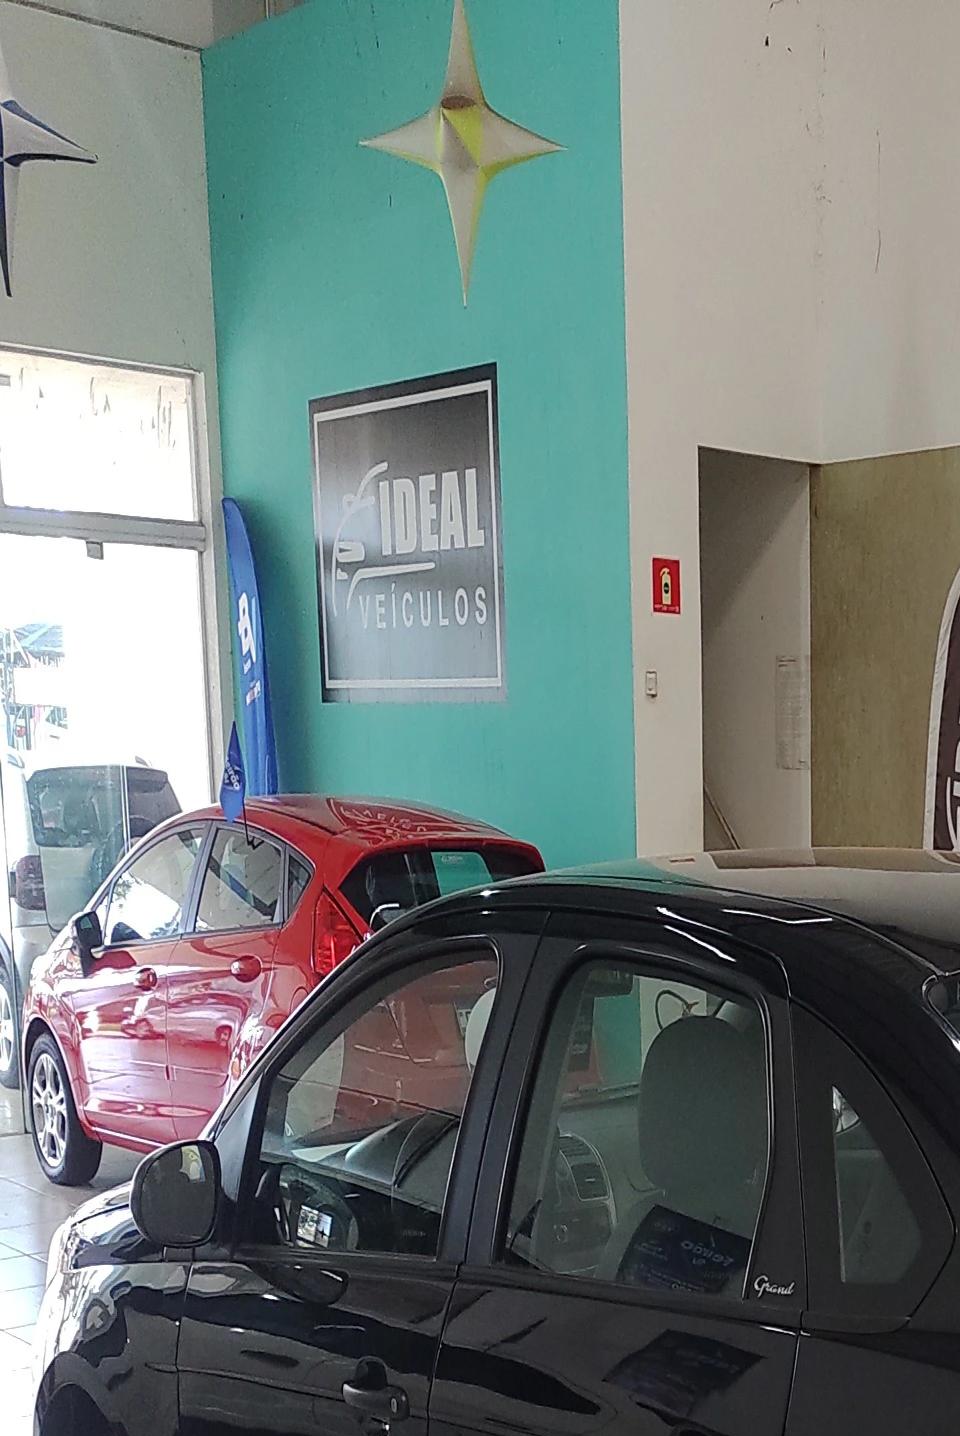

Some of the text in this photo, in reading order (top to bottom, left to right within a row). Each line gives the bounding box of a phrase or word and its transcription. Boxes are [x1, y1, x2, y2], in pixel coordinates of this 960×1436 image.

[379, 468, 485, 556] IDEAL
[359, 583, 488, 630] VEÍCULOS
[754, 1275, 795, 1298] Grand
